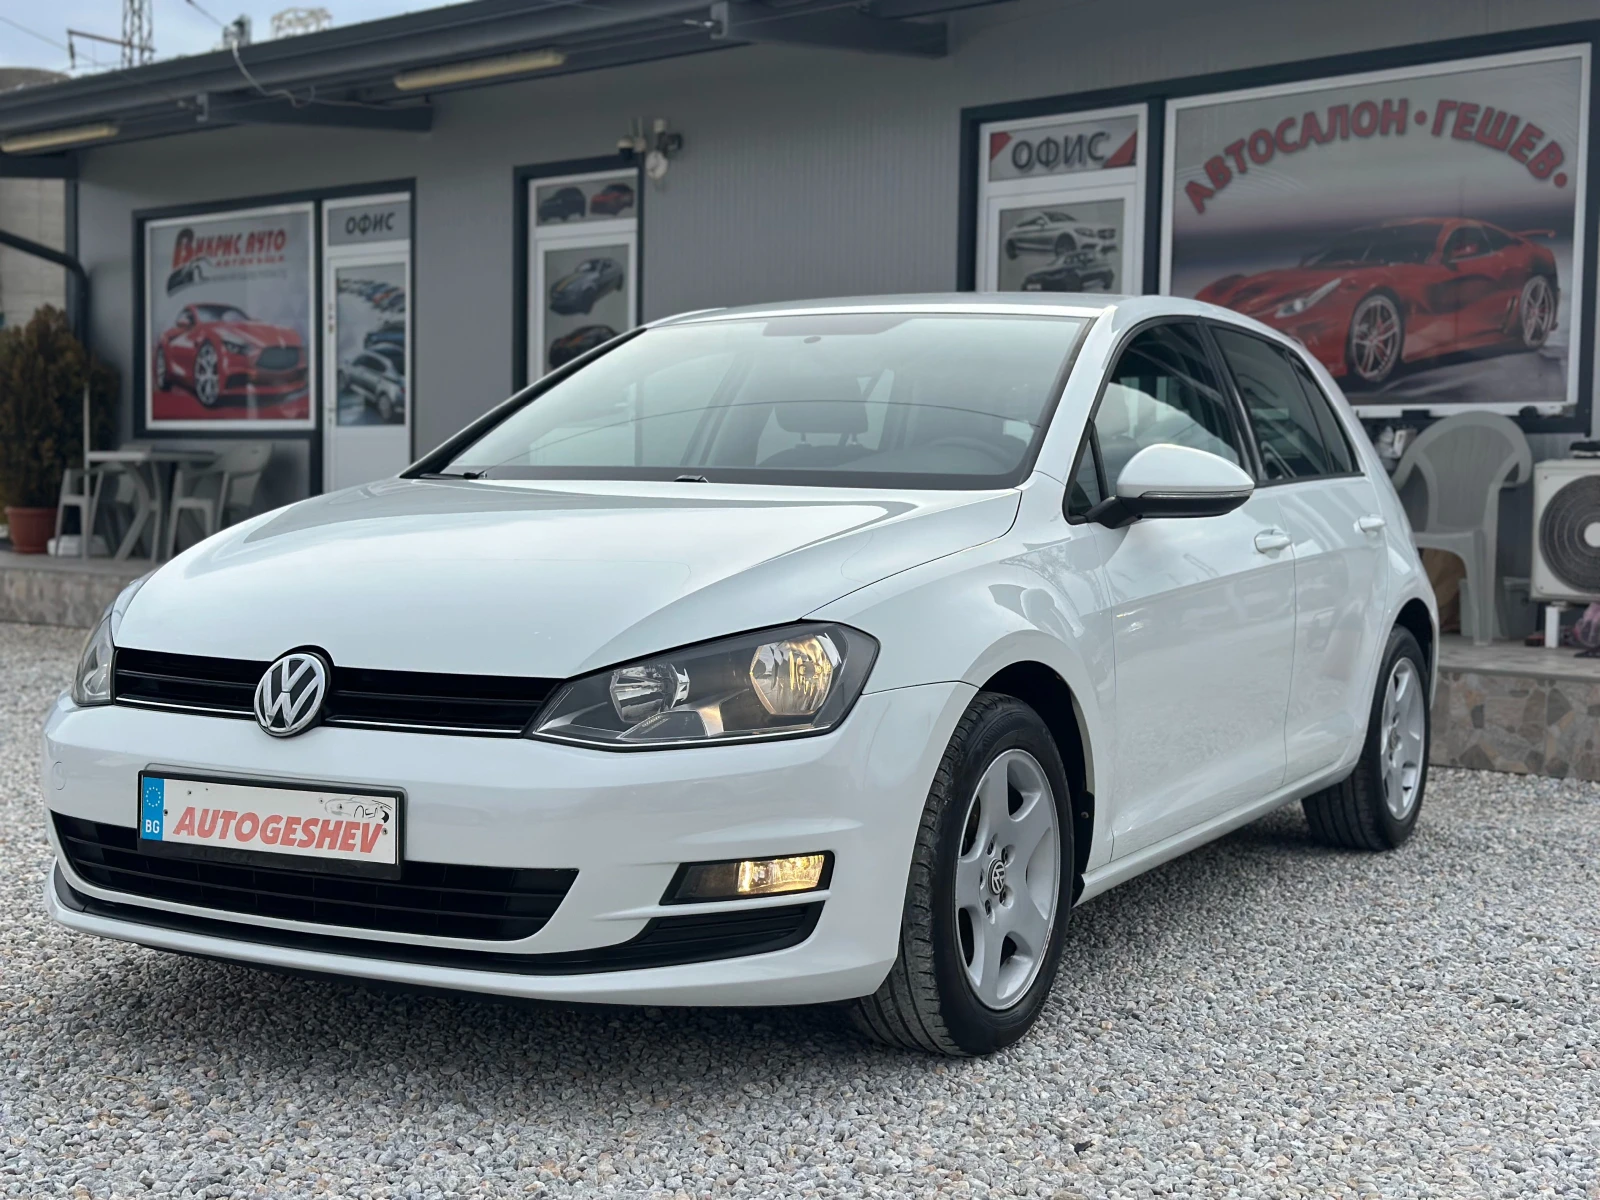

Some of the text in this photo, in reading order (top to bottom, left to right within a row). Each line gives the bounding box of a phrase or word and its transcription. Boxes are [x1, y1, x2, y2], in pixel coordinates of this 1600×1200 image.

[1012, 131, 1110, 171] ОФИС
[1184, 99, 1408, 214] АВТОСАЛОН
[345, 212, 396, 236] ОФИС
[145, 819, 160, 834] BG
[172, 806, 384, 853] AUTOGESHEV
